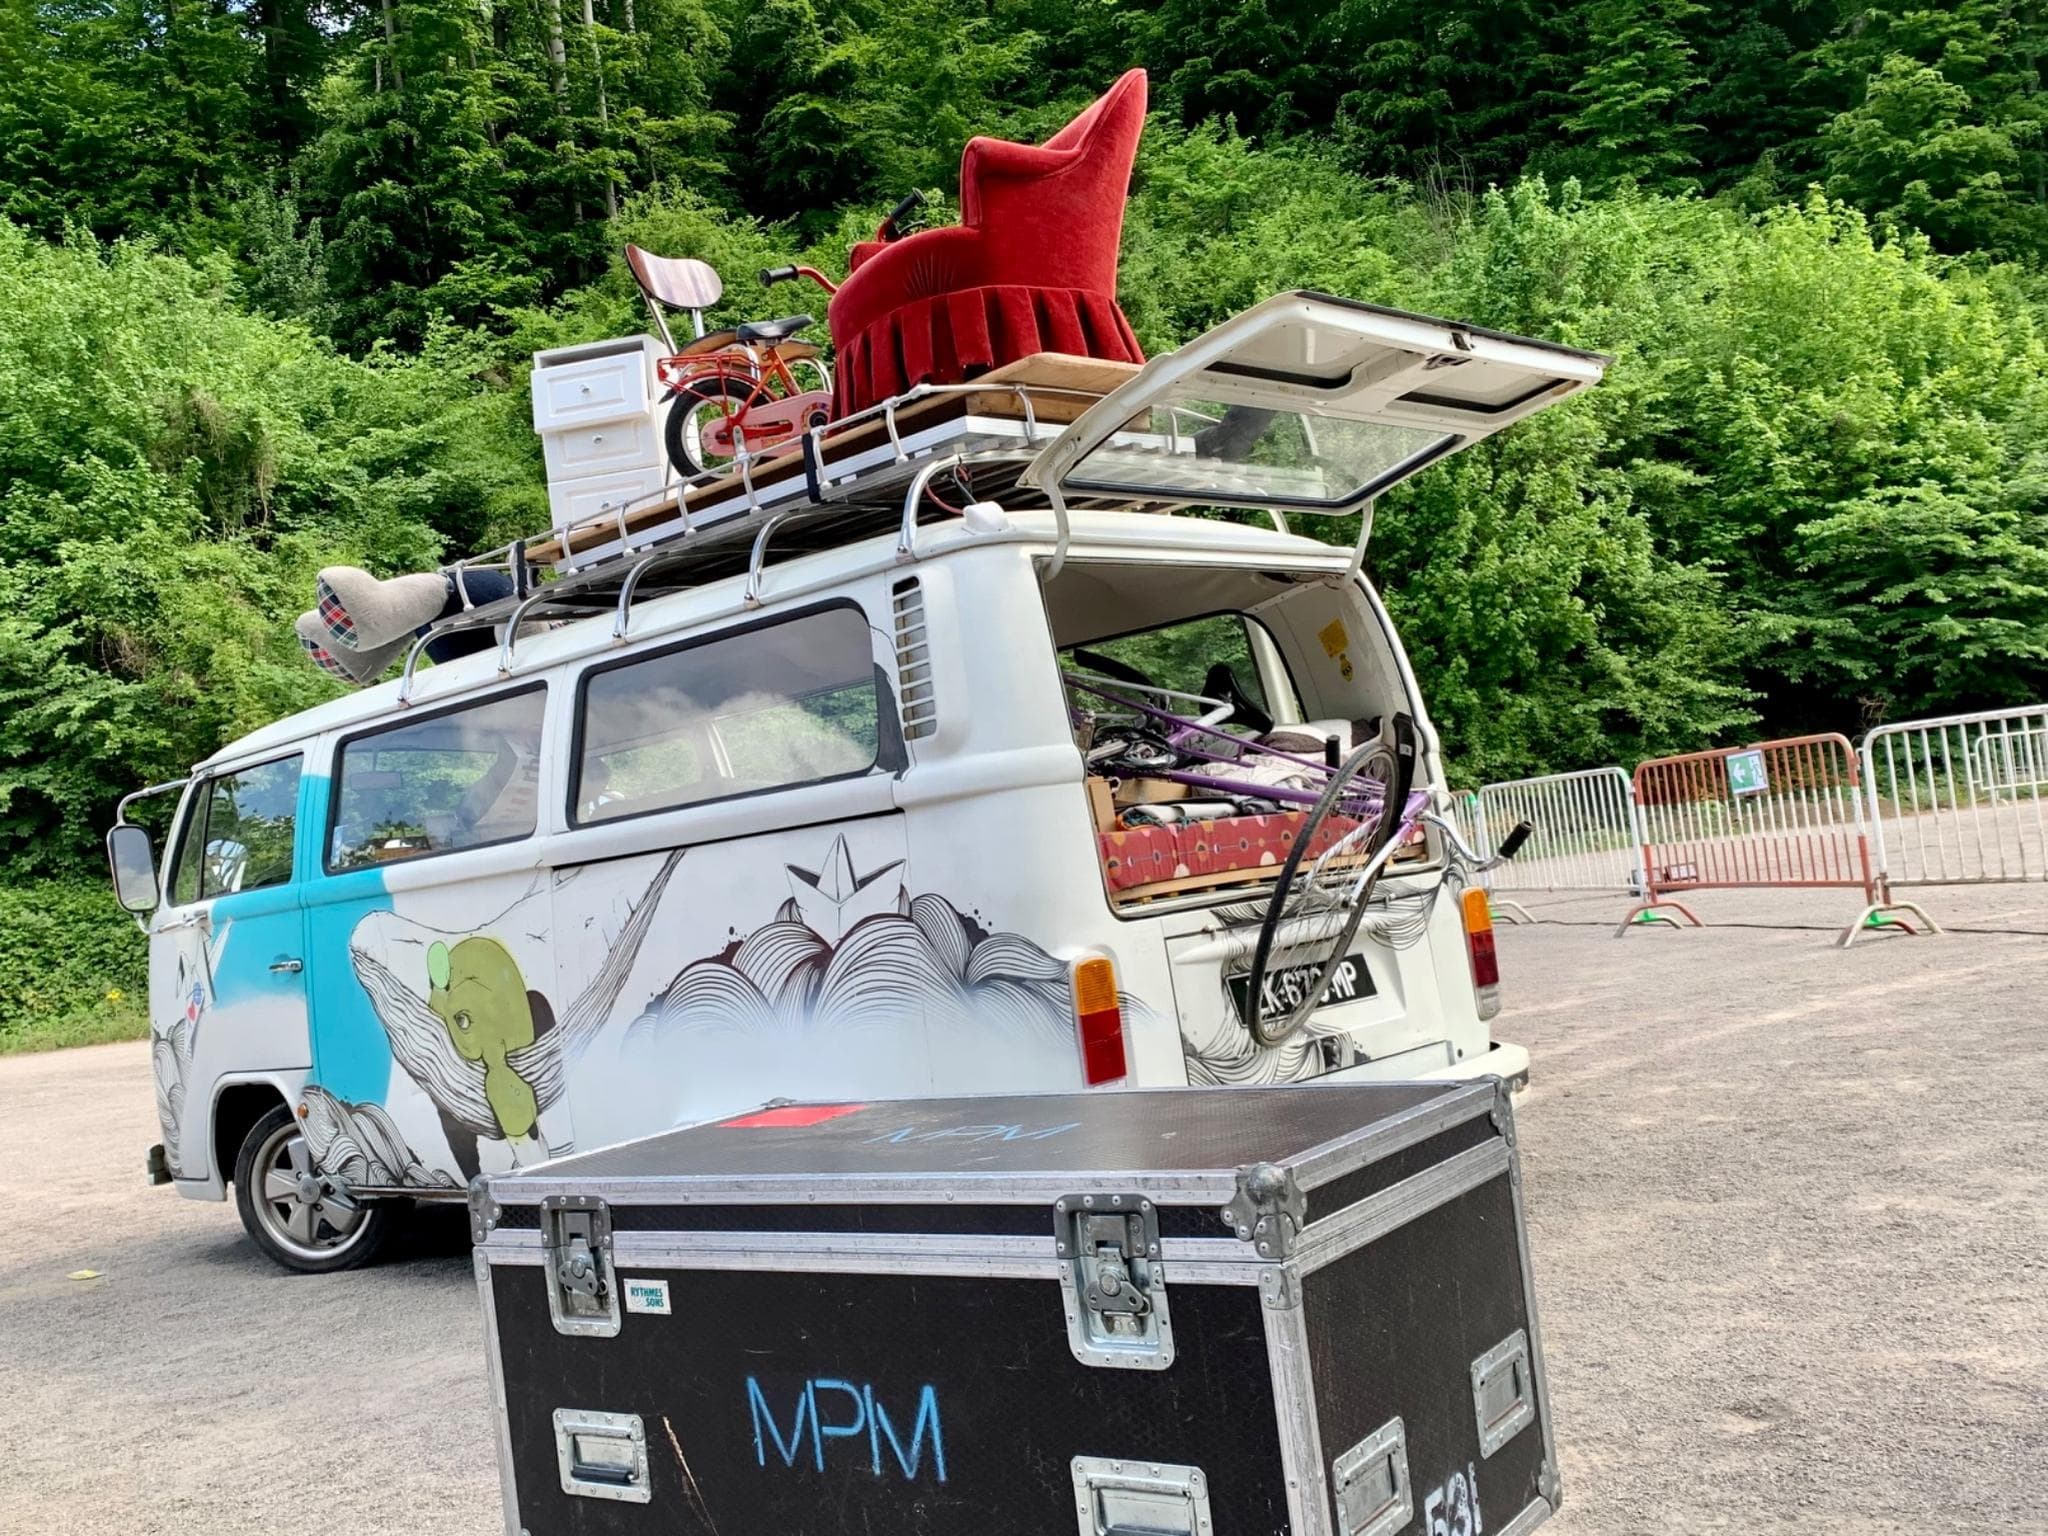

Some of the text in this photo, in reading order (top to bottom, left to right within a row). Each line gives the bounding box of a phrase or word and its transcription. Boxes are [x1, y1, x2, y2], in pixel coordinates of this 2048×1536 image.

[863, 1122, 1082, 1144] MPM
[631, 1287, 663, 1297] RYTHMES
[646, 1298, 664, 1307] SONS
[747, 1376, 946, 1482] MPM
